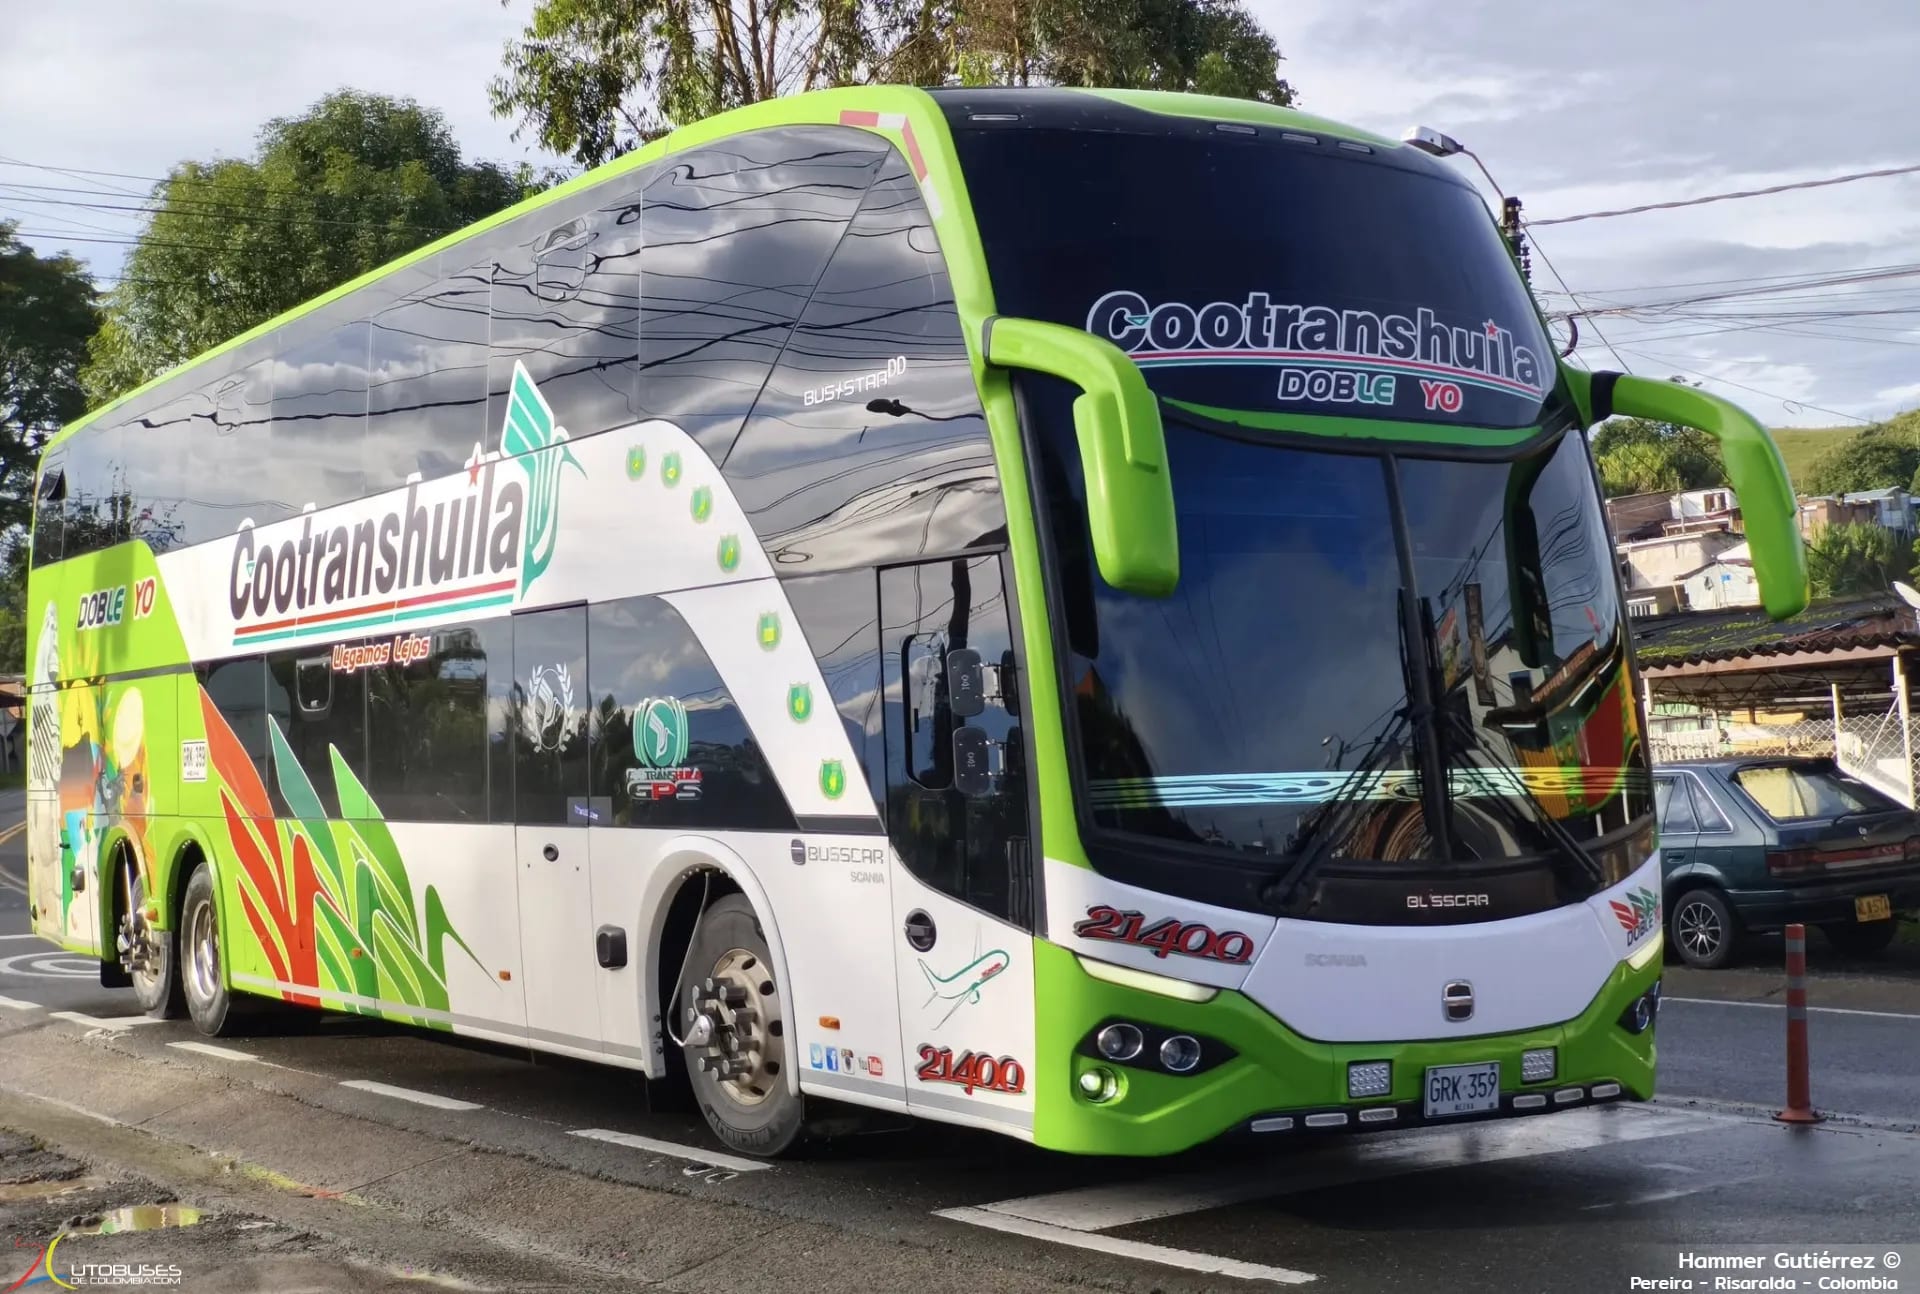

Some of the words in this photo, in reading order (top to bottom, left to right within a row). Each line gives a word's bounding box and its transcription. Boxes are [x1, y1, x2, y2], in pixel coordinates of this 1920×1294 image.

[1086, 290, 1543, 388] Cootranshuila
[1277, 369, 1396, 405] DOBLE
[1419, 379, 1463, 413] YO
[229, 450, 524, 621] Cootranshuila
[77, 586, 125, 629] DOBLE
[134, 577, 155, 619] YO
[331, 640, 391, 674] Llegamos
[393, 634, 431, 665] Lejos
[627, 780, 703, 801] GPS
[808, 846, 884, 864] BUSSCAR
[850, 871, 885, 885] SCANIA
[1073, 903, 1254, 966] 21400
[1304, 953, 1368, 967] SCANIA
[915, 1042, 1027, 1096] 21400
